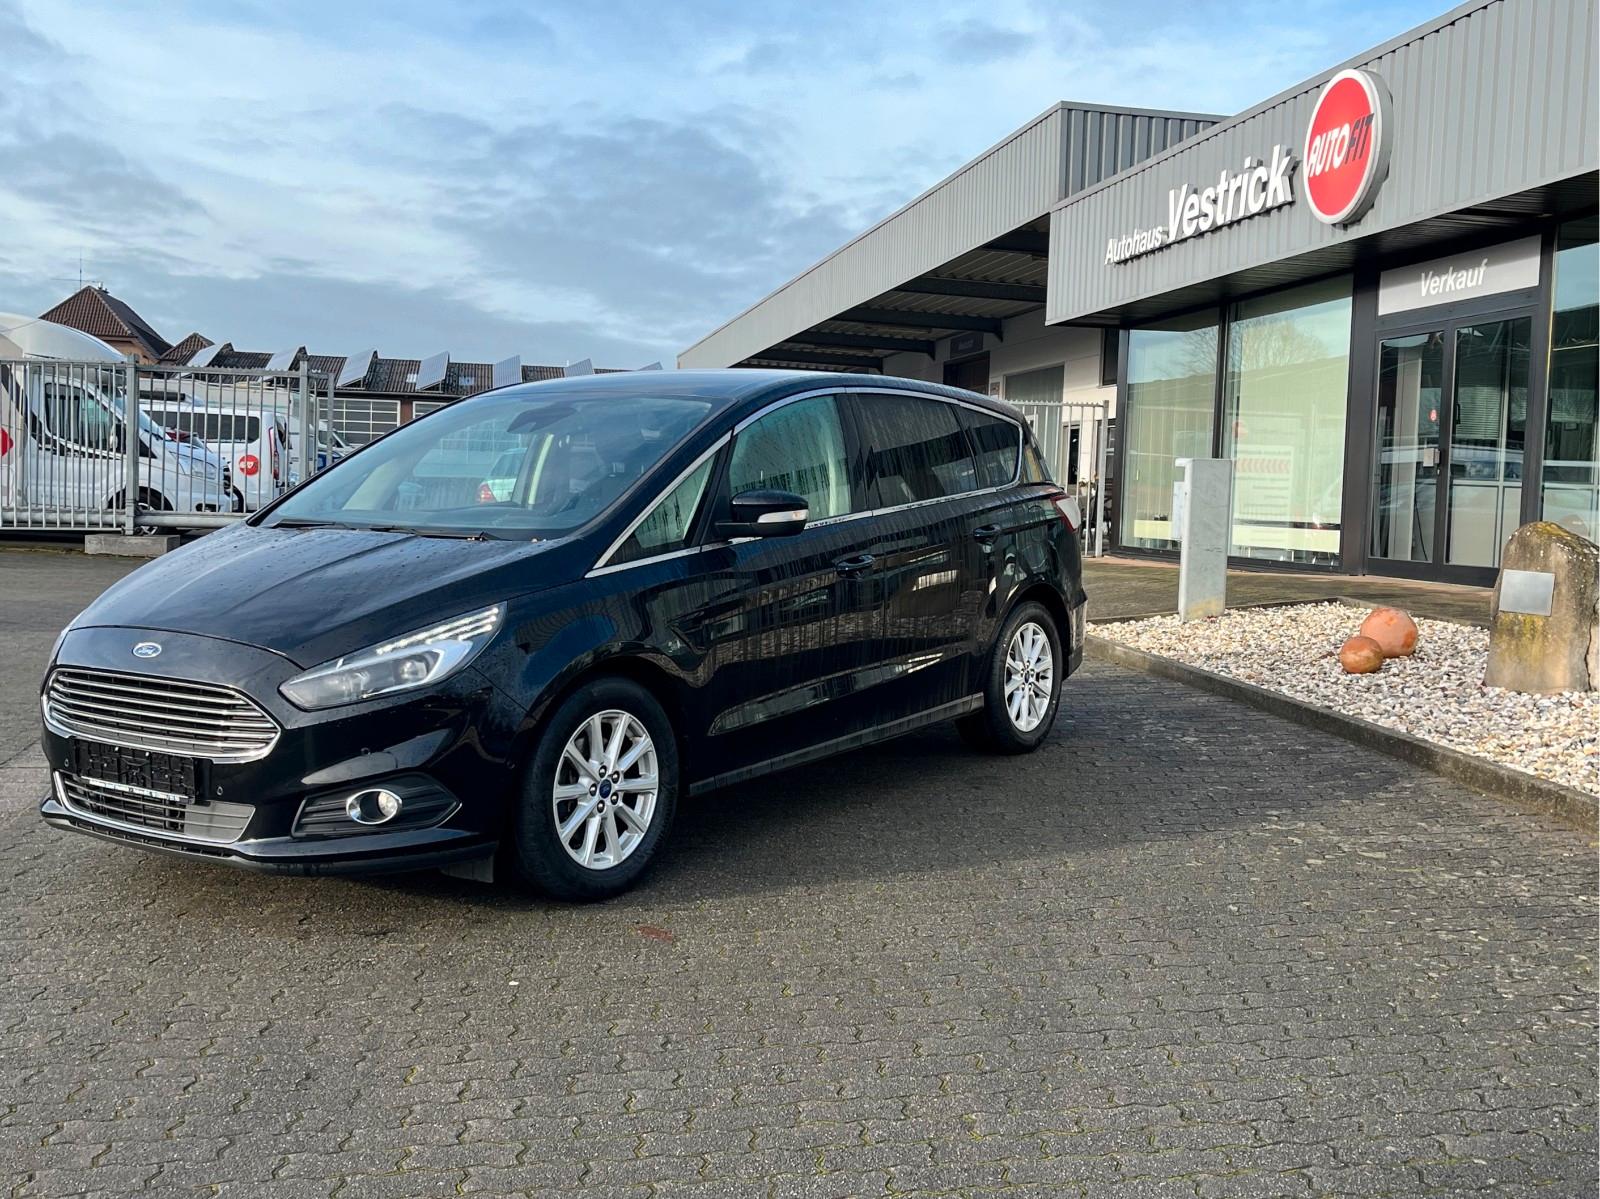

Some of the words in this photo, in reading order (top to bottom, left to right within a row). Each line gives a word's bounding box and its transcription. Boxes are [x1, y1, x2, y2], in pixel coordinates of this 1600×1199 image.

[1307, 113, 1375, 178] AUTOFIT
[1104, 225, 1163, 264] Autohaus
[1167, 143, 1294, 242] Vestrick
[1421, 258, 1488, 296] Verkauf
